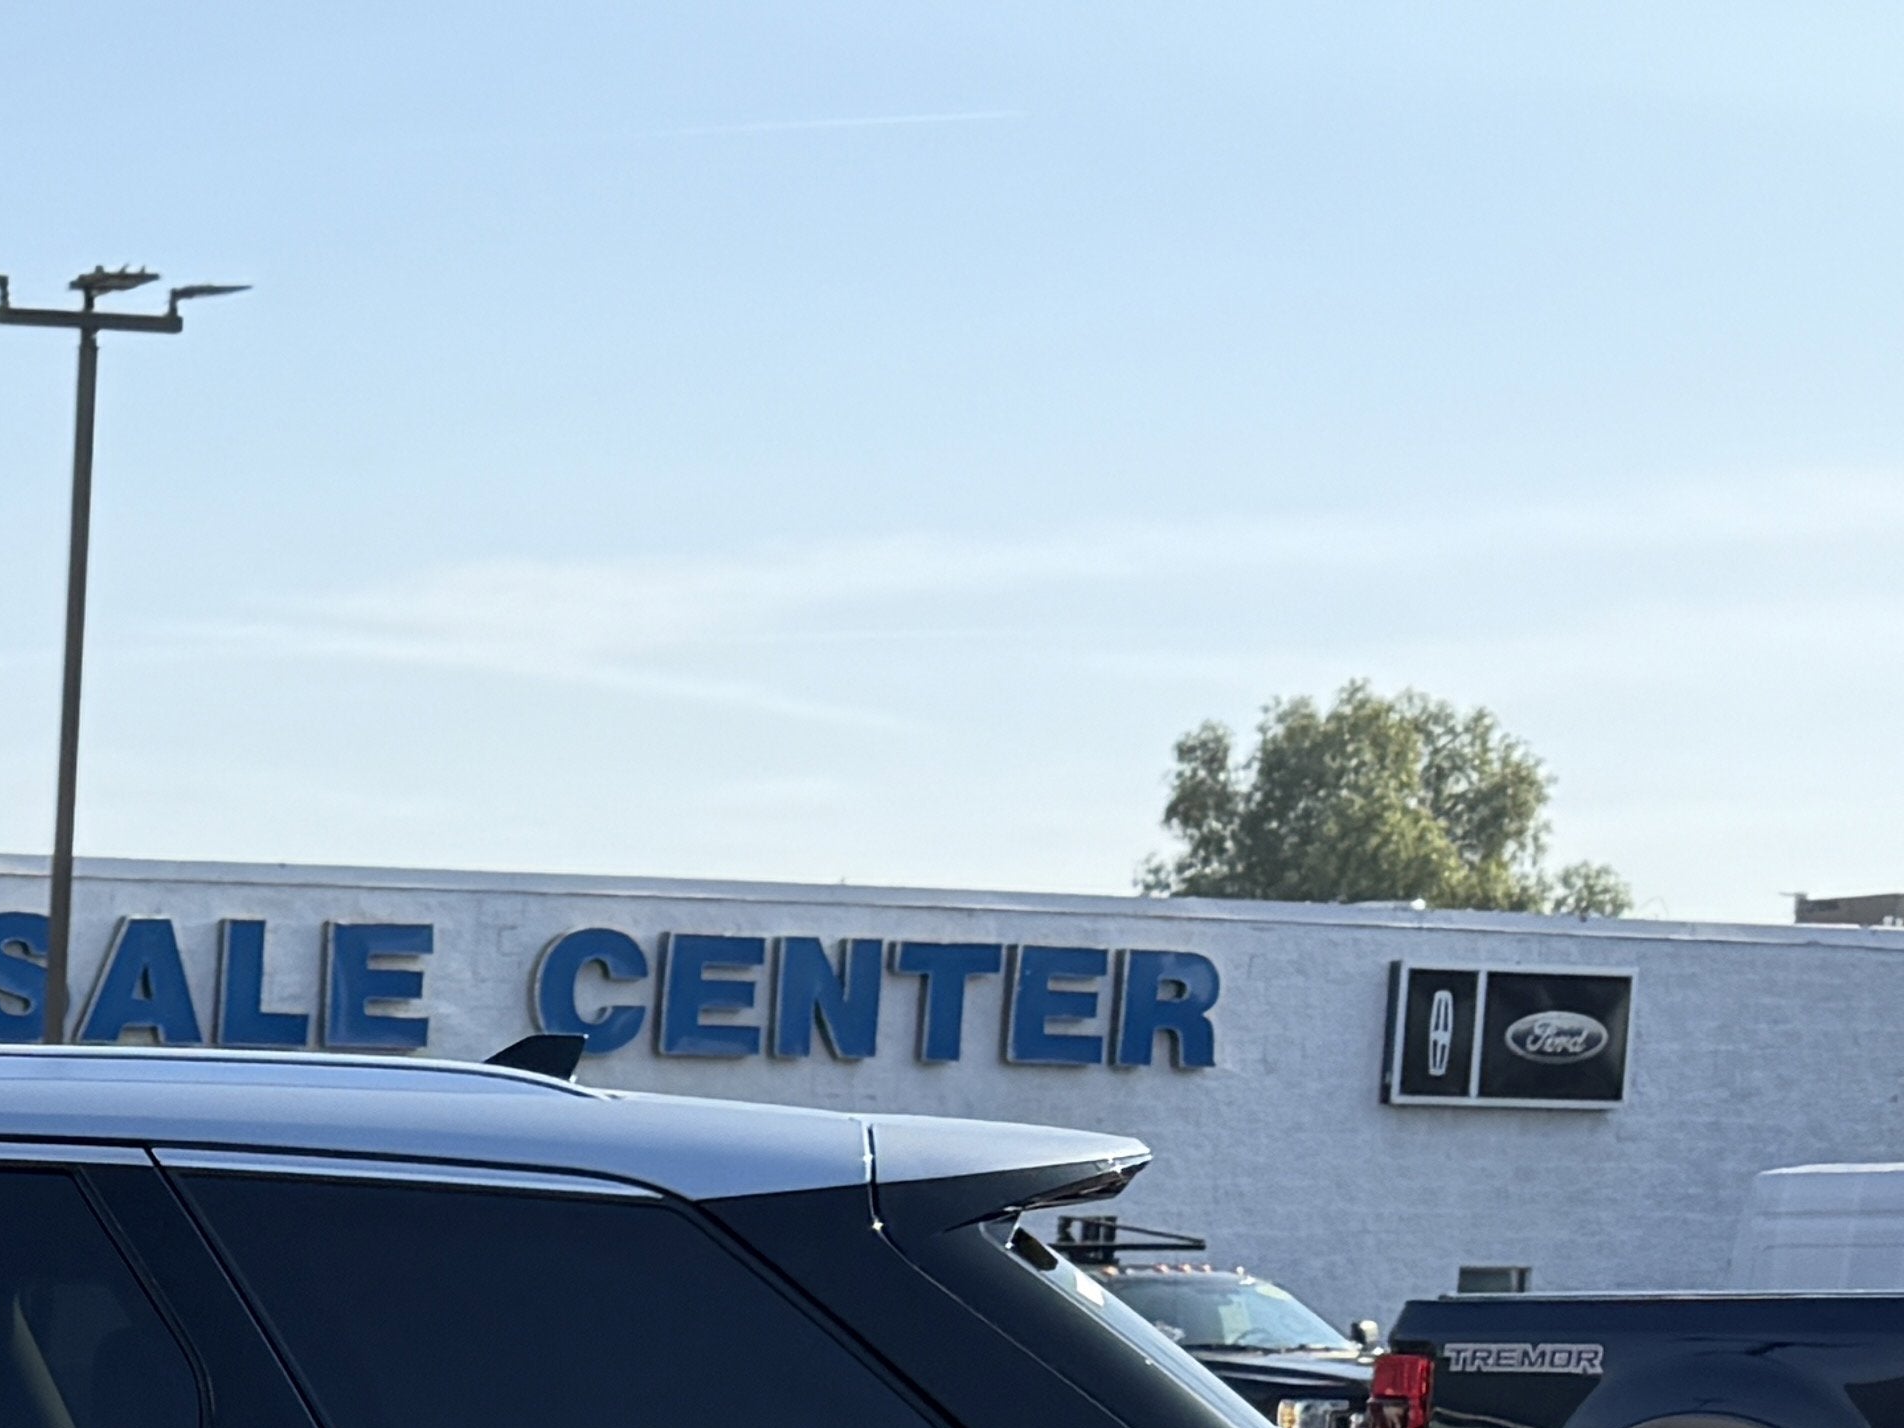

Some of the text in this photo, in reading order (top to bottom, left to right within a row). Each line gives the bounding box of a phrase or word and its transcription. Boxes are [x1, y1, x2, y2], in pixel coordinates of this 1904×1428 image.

[532, 927, 1221, 1068] CENTER
[1526, 1021, 1589, 1053] Ford
[1444, 1343, 1603, 1374] TREMOR
